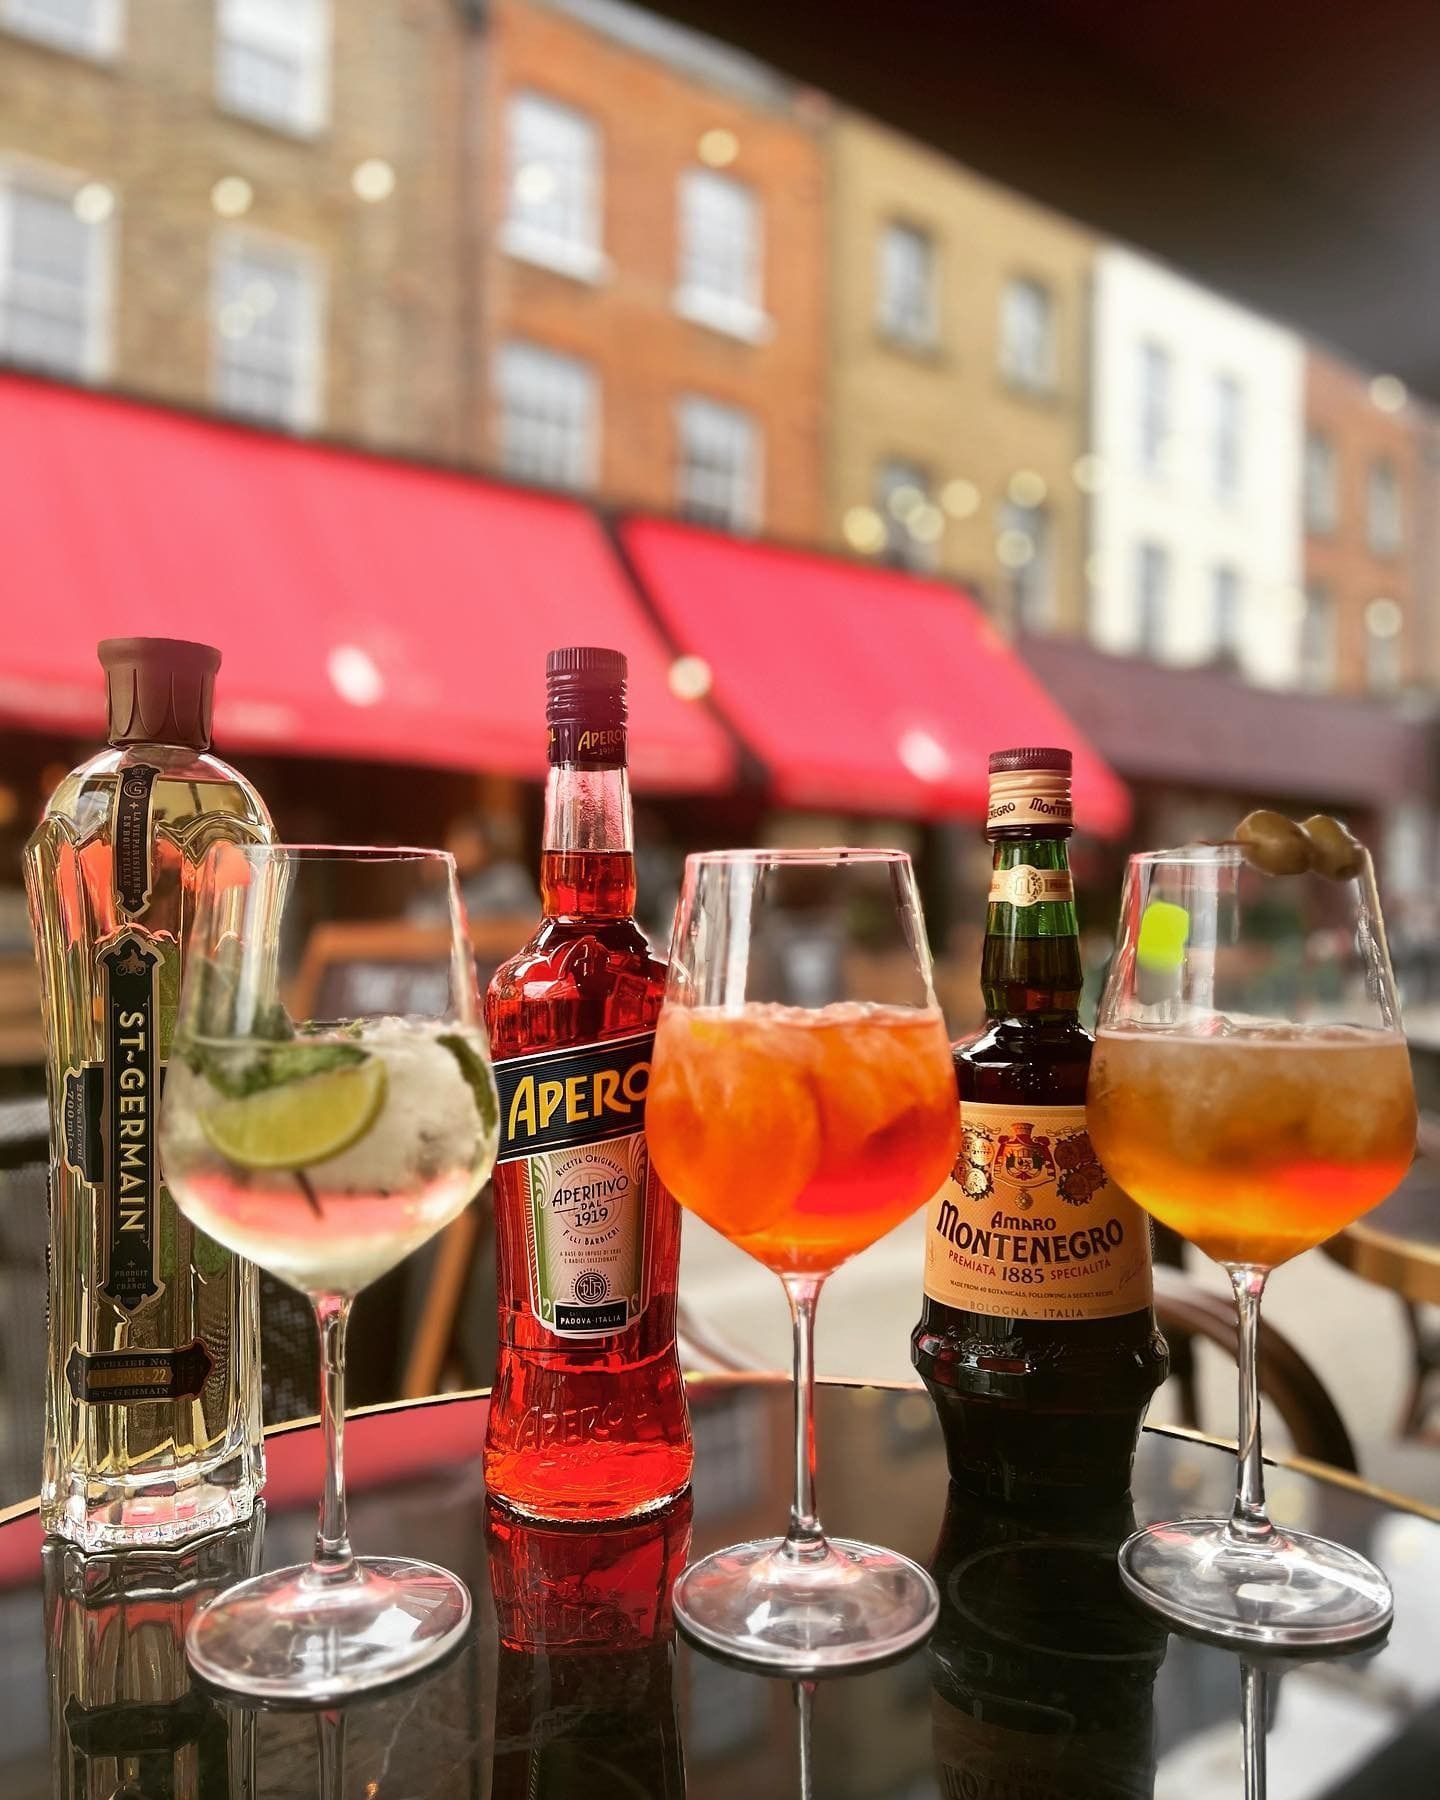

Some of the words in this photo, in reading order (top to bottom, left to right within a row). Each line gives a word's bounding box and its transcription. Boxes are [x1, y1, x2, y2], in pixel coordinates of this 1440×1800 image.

[555, 1159, 583, 1176] RICETTA
[585, 1154, 624, 1175] ORIGINALE
[552, 1175, 629, 1207] APERITIVO
[580, 1200, 602, 1211] DAL
[575, 1207, 609, 1228] 1919
[990, 1210, 1057, 1231] AMARO
[584, 1226, 621, 1246] BARBIERI
[936, 1199, 1124, 1266] MONTENEGRO
[948, 1249, 997, 1278] PREMIATA
[1002, 1266, 1045, 1284] 1885
[950, 1279, 962, 1288] MADE
[963, 1281, 979, 1291] FROM
[1028, 1291, 1066, 1299] FOLLOWING
[969, 1300, 1029, 1318] BOLOGNA
[1043, 1308, 1084, 1319] ITALIA
